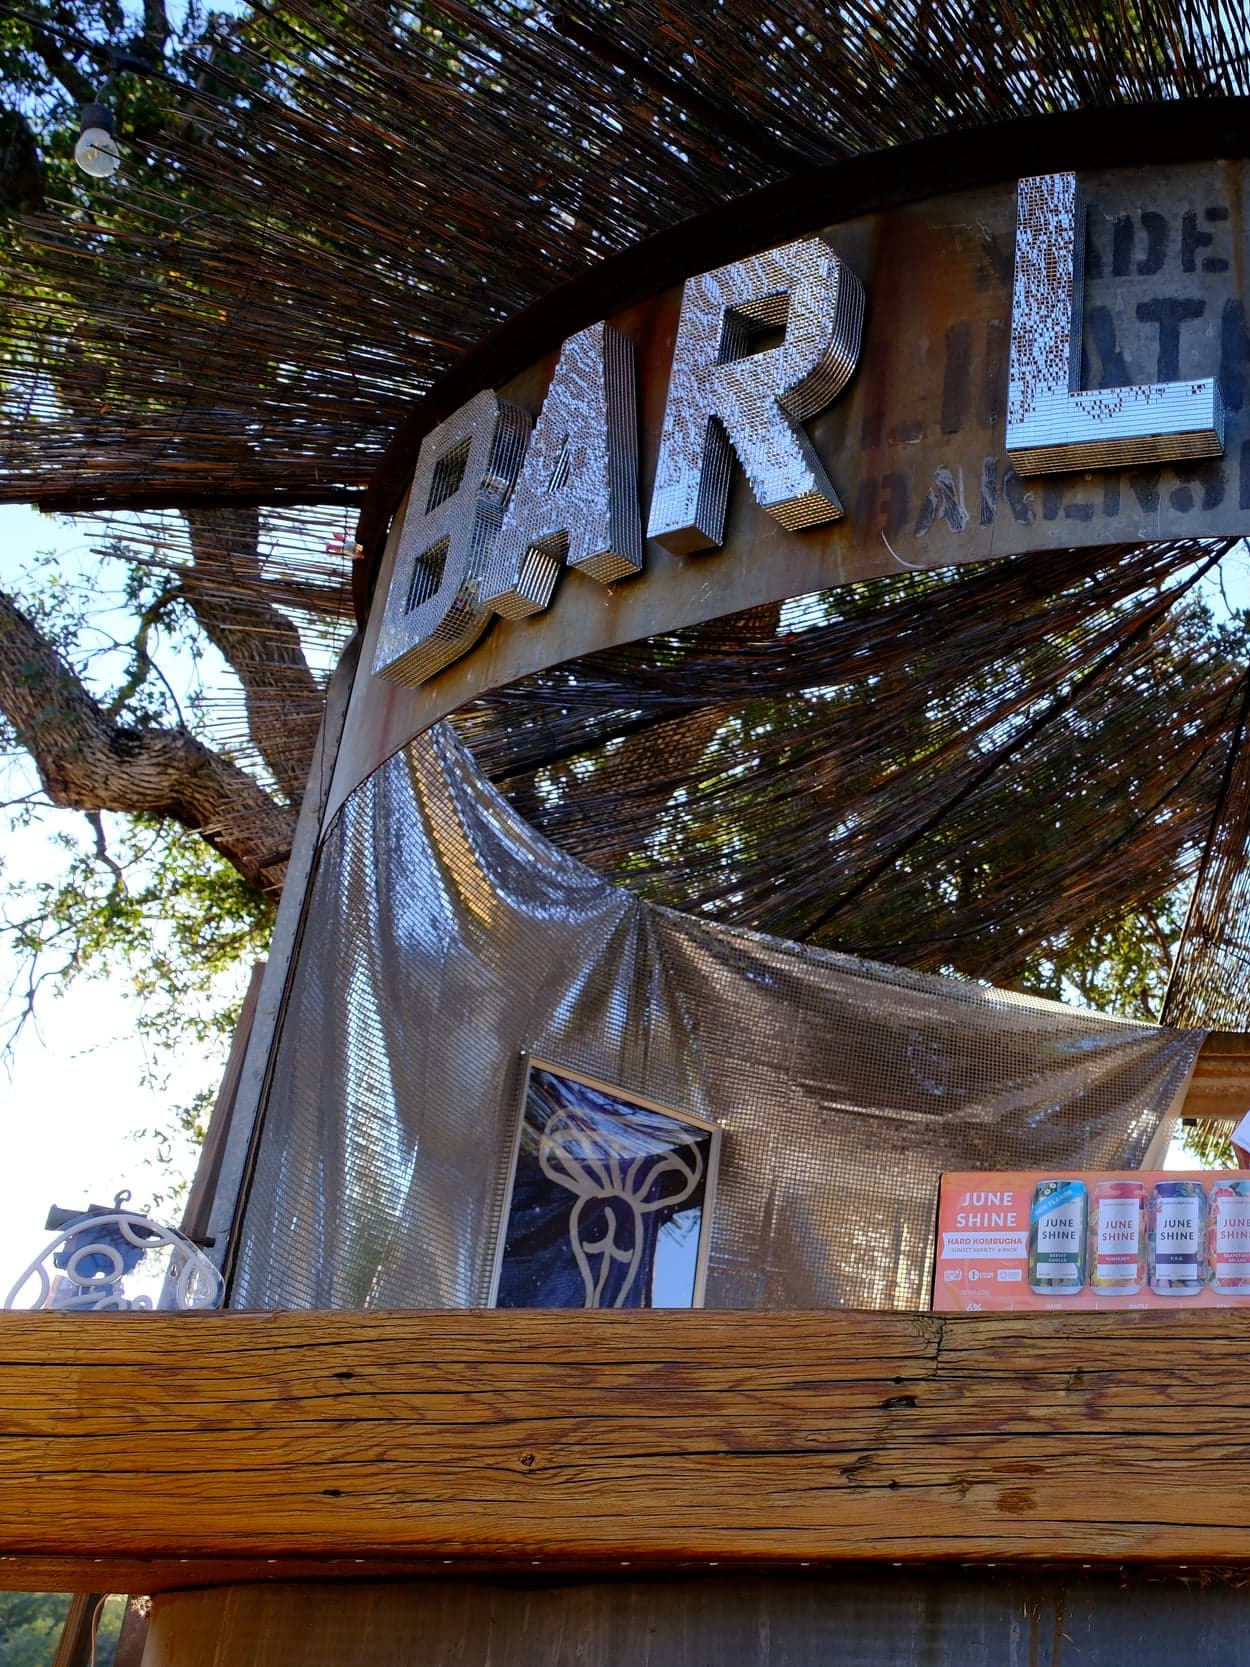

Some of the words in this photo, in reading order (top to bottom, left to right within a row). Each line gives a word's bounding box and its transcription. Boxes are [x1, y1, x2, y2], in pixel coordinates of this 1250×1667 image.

[371, 233, 868, 688] BAR
[962, 1192, 1013, 1207] JUNE
[956, 1212, 1017, 1227] SHINE
[1045, 1219, 1074, 1228] JUNE
[1162, 1219, 1193, 1228] JUNE
[1104, 1220, 1134, 1229] JUNE
[1042, 1231, 1076, 1240] SHINE
[1102, 1232, 1136, 1241] SHINE
[1160, 1231, 1195, 1241] SHINE
[947, 1237, 972, 1246] HARD
[972, 1237, 1023, 1246] KOMBUCHA
[966, 1303, 983, 1311] 6%
